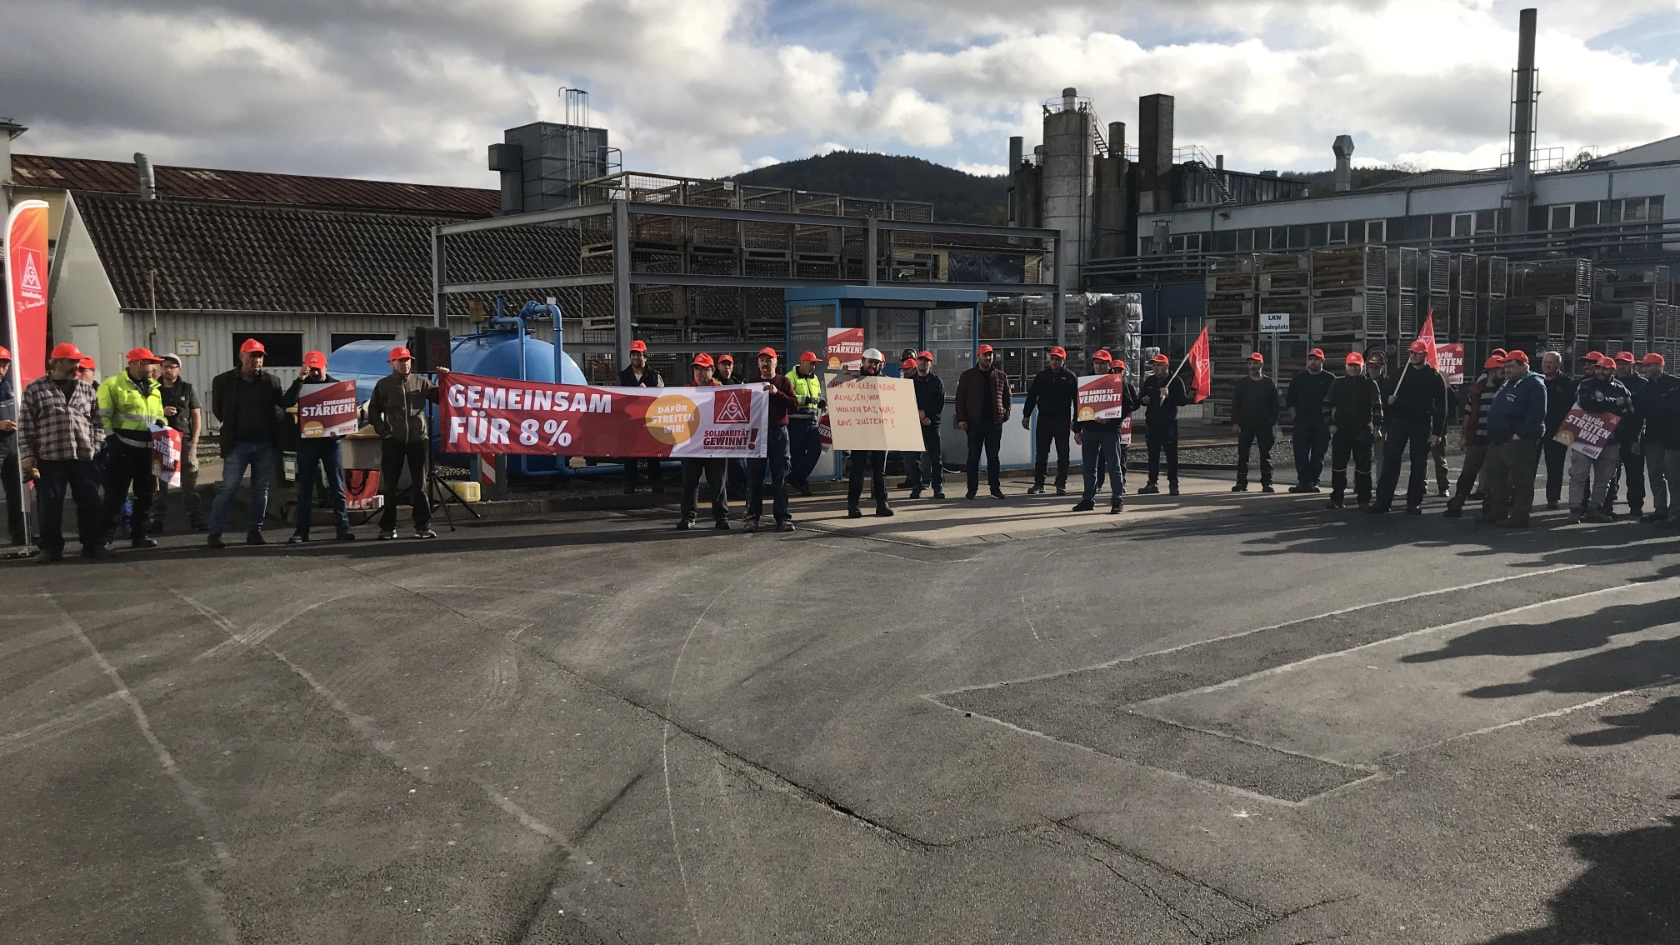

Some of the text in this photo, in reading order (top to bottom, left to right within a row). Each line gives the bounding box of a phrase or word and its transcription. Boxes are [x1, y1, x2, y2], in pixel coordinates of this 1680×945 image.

[828, 344, 862, 354] STÄRKEN!
[1438, 358, 1463, 366] EITEN
[831, 380, 843, 389] WIR
[847, 382, 876, 390] WOLLEN
[448, 384, 612, 414] GEMEINSAM
[1079, 393, 1122, 404] VERDIENT!
[301, 402, 355, 417] STÄRKEN!
[657, 404, 688, 414] DAFÜR
[836, 406, 862, 414] WOLLEN
[879, 406, 895, 414] WAS
[652, 413, 695, 424] STREITEN
[837, 419, 852, 427] UNS
[1582, 413, 1605, 428] DAFÜR
[448, 410, 511, 445] FÜR
[663, 424, 685, 434] WIR!
[1565, 414, 1611, 439] STREITEN
[704, 429, 750, 437] SOLIDARITÄT
[1578, 429, 1600, 445] WIR
[153, 438, 181, 462] STREITEN
